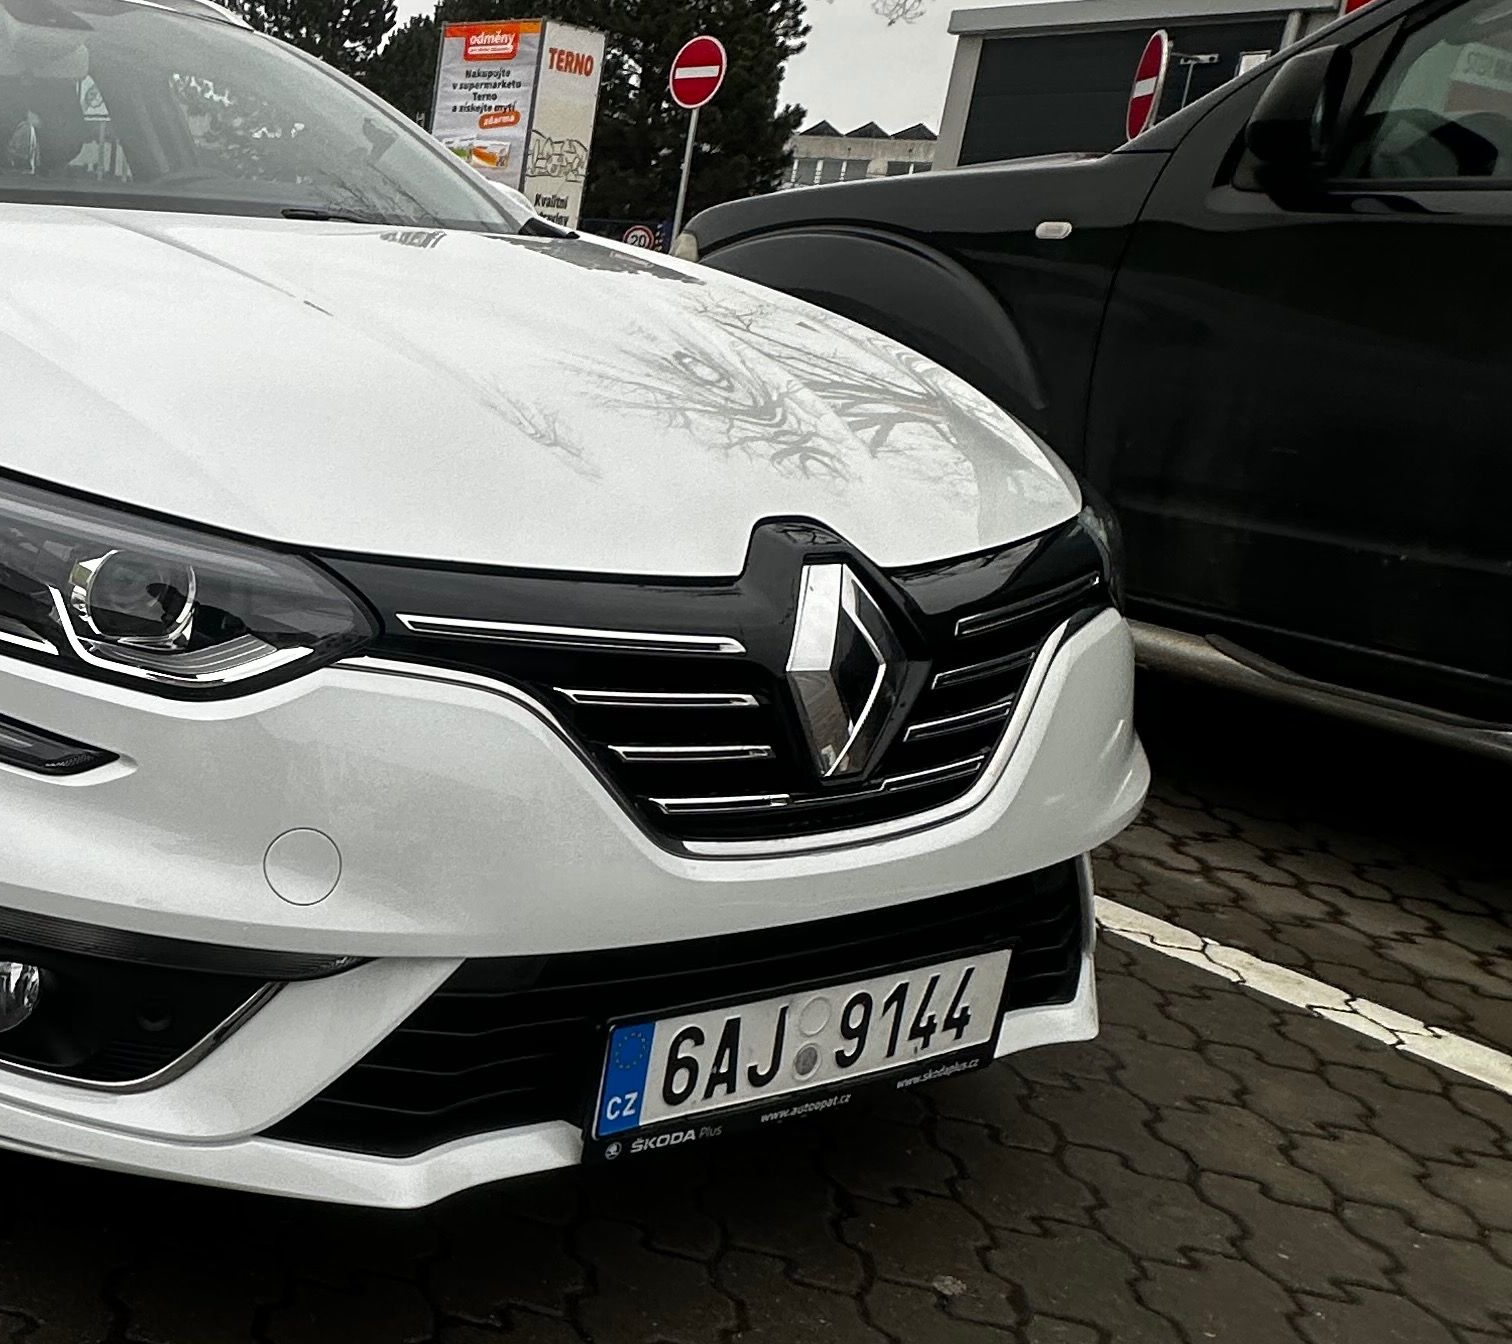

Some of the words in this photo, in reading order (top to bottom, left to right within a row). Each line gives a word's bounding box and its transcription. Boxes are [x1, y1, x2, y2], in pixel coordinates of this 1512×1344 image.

[470, 30, 516, 46] odměny
[548, 47, 594, 77] TERNO
[465, 67, 511, 79] Nakupujte
[458, 80, 522, 91] supermarketu
[472, 92, 498, 101] Terno
[452, 105, 457, 113] a
[458, 102, 493, 113] získejte
[483, 115, 515, 126] zdarma
[534, 192, 569, 209] Kvalitní
[630, 234, 647, 248] 20
[661, 1005, 791, 1107] 6AJ
[834, 967, 976, 1069] 9144
[896, 1057, 980, 1089] www.skodaplus.cz
[606, 1091, 639, 1121] CZ
[630, 1129, 696, 1154] ŠKODA
[699, 1125, 723, 1139] Plus
